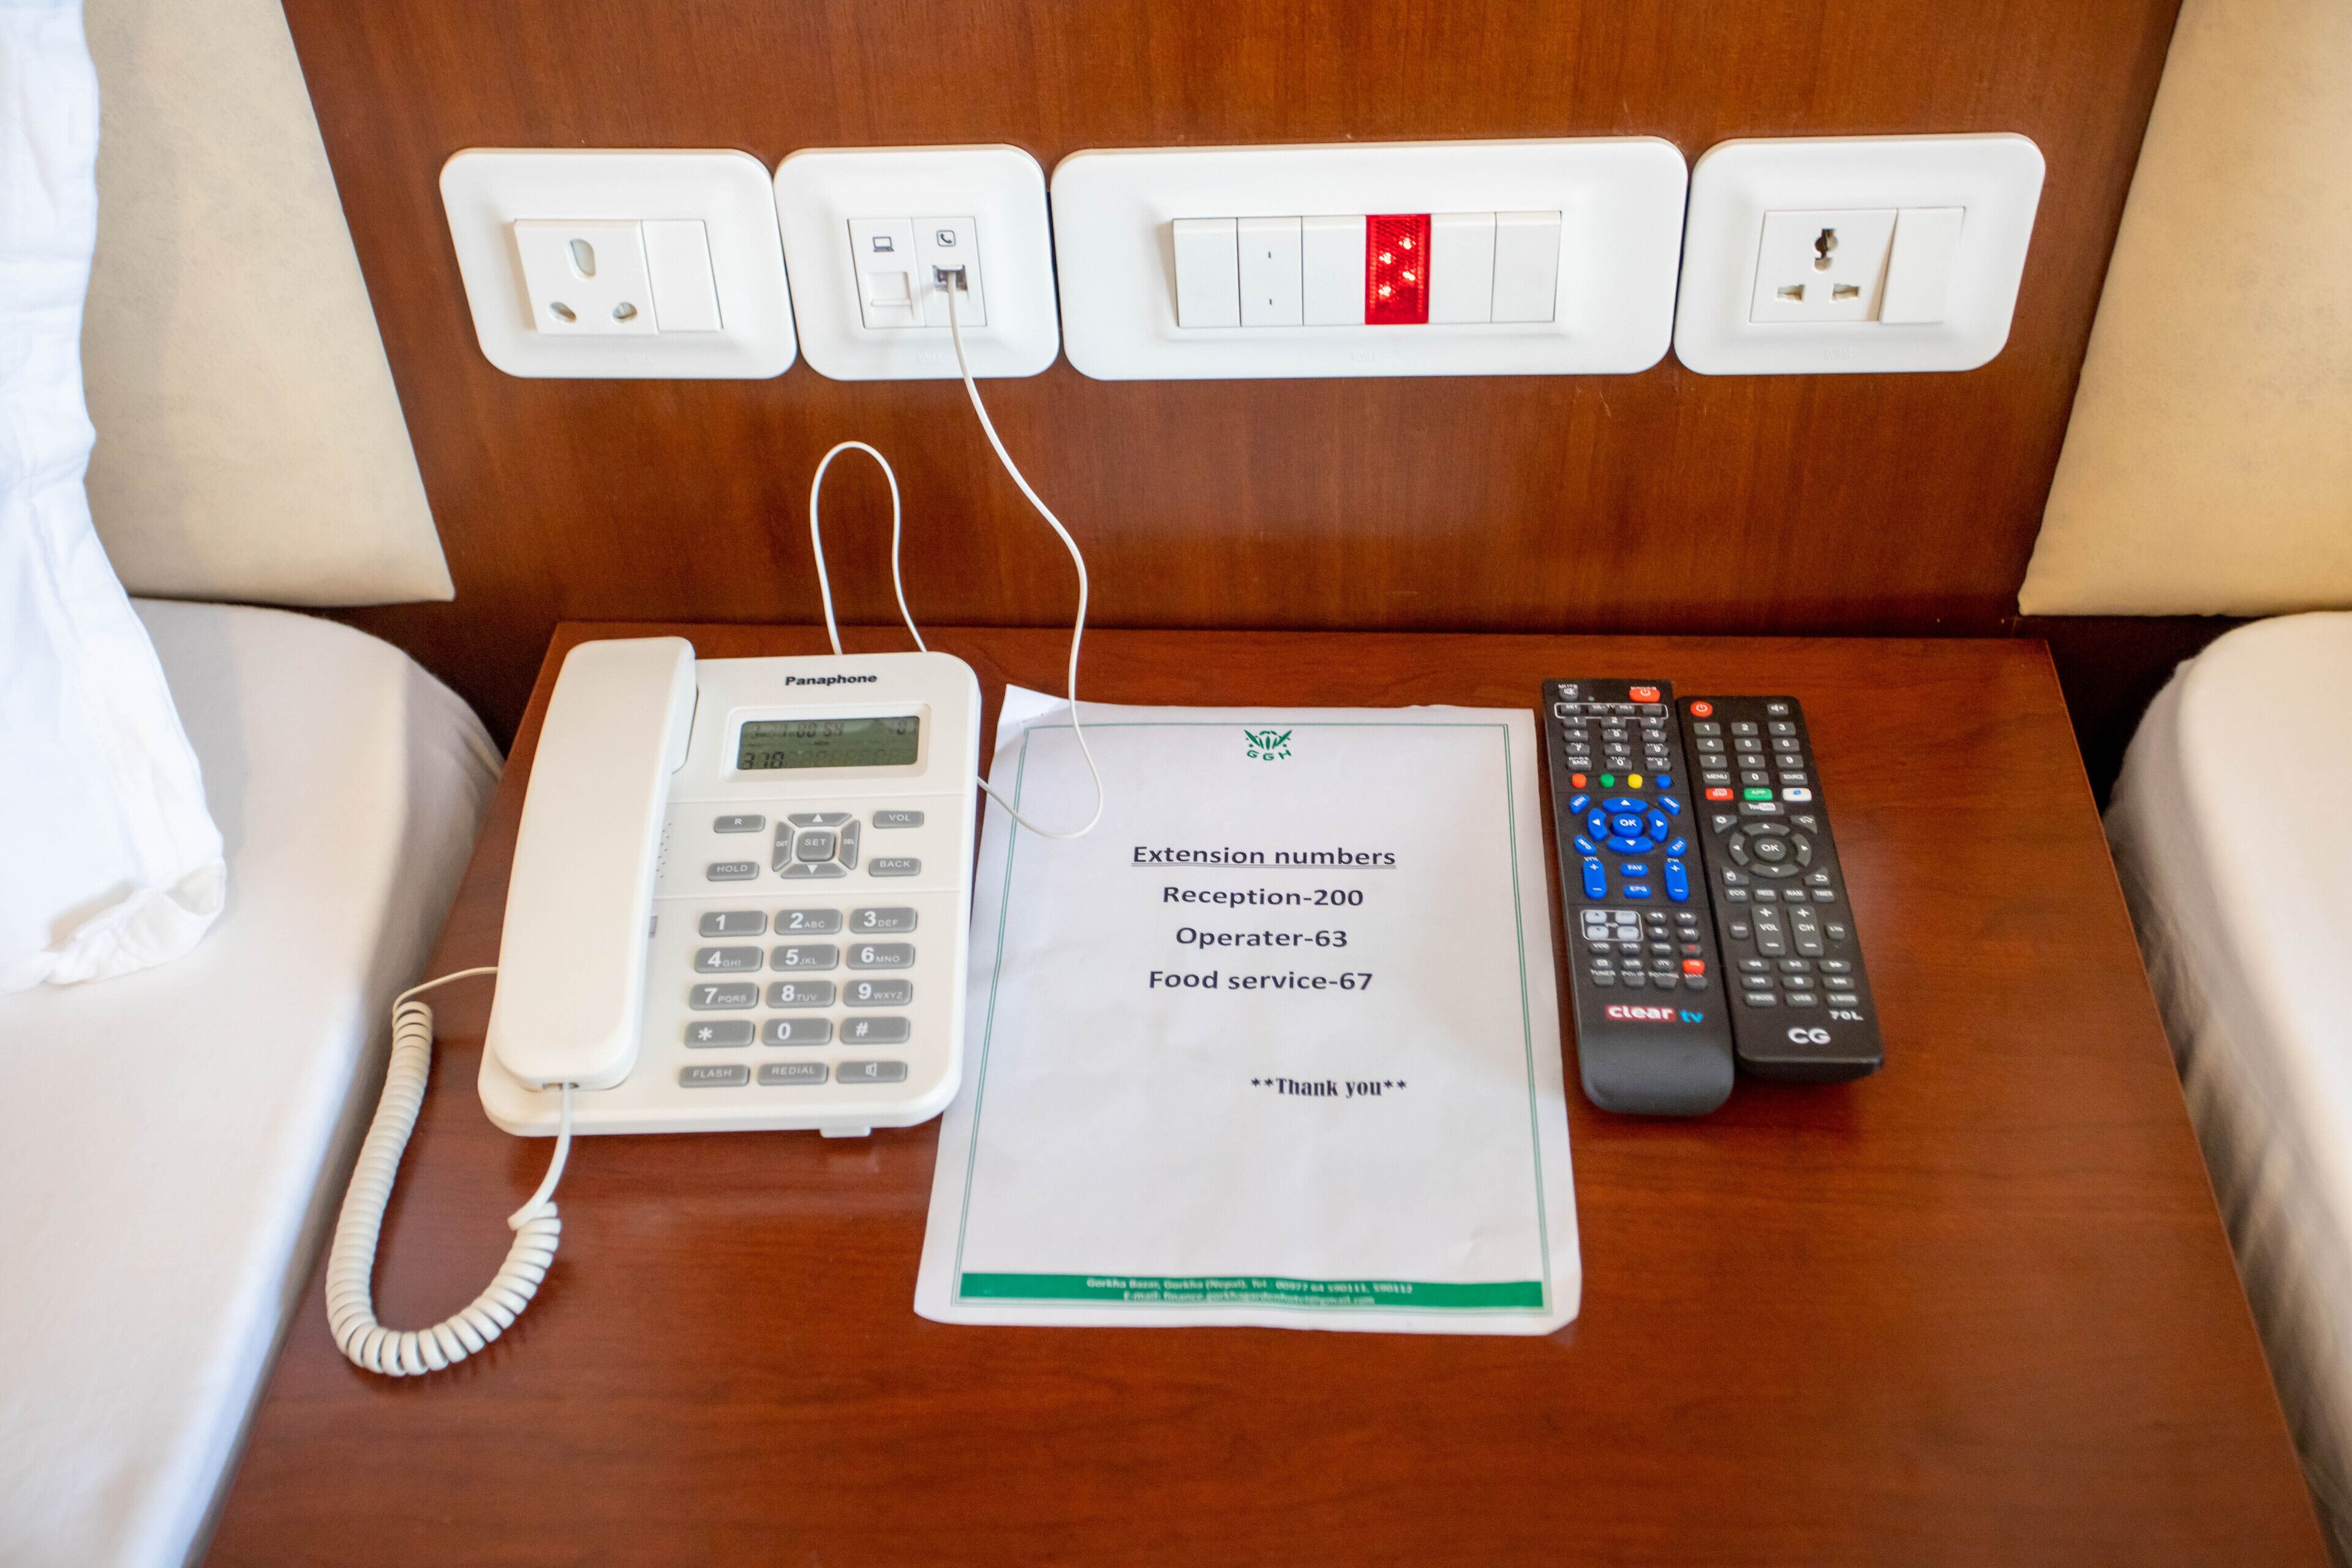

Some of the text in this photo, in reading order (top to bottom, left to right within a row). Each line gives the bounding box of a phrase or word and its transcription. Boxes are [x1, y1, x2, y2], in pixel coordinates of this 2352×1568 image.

[785, 674, 878, 687] Panaphone
[1246, 750, 1292, 761] GGH
[888, 813, 911, 823] VOL
[1133, 846, 1396, 865] Extension numbers
[1761, 844, 1780, 853] OK
[717, 864, 748, 873] HOLD
[879, 860, 911, 869] BACK
[1163, 886, 1364, 908] Reception-200
[716, 914, 726, 931] 1
[790, 913, 825, 929] 2 ABC
[864, 911, 876, 927] 3
[1758, 923, 1779, 932] VOL
[1798, 923, 1815, 932] CH
[1175, 927, 1348, 949] Operater-63
[707, 951, 742, 968] 4 GHI
[785, 949, 818, 967] 5 JKL
[861, 946, 901, 963] 6 MNO
[1148, 970, 1373, 990] Food service-67
[704, 987, 747, 1005] 7 PQRS
[781, 985, 795, 1003] 8
[858, 983, 903, 1000] 9 WXYZ
[1607, 1005, 1705, 1023] clear tv
[777, 1022, 791, 1040] 0
[1787, 1027, 1832, 1044] CG
[692, 1069, 732, 1079] FLASH
[771, 1066, 815, 1076] REDIAL
